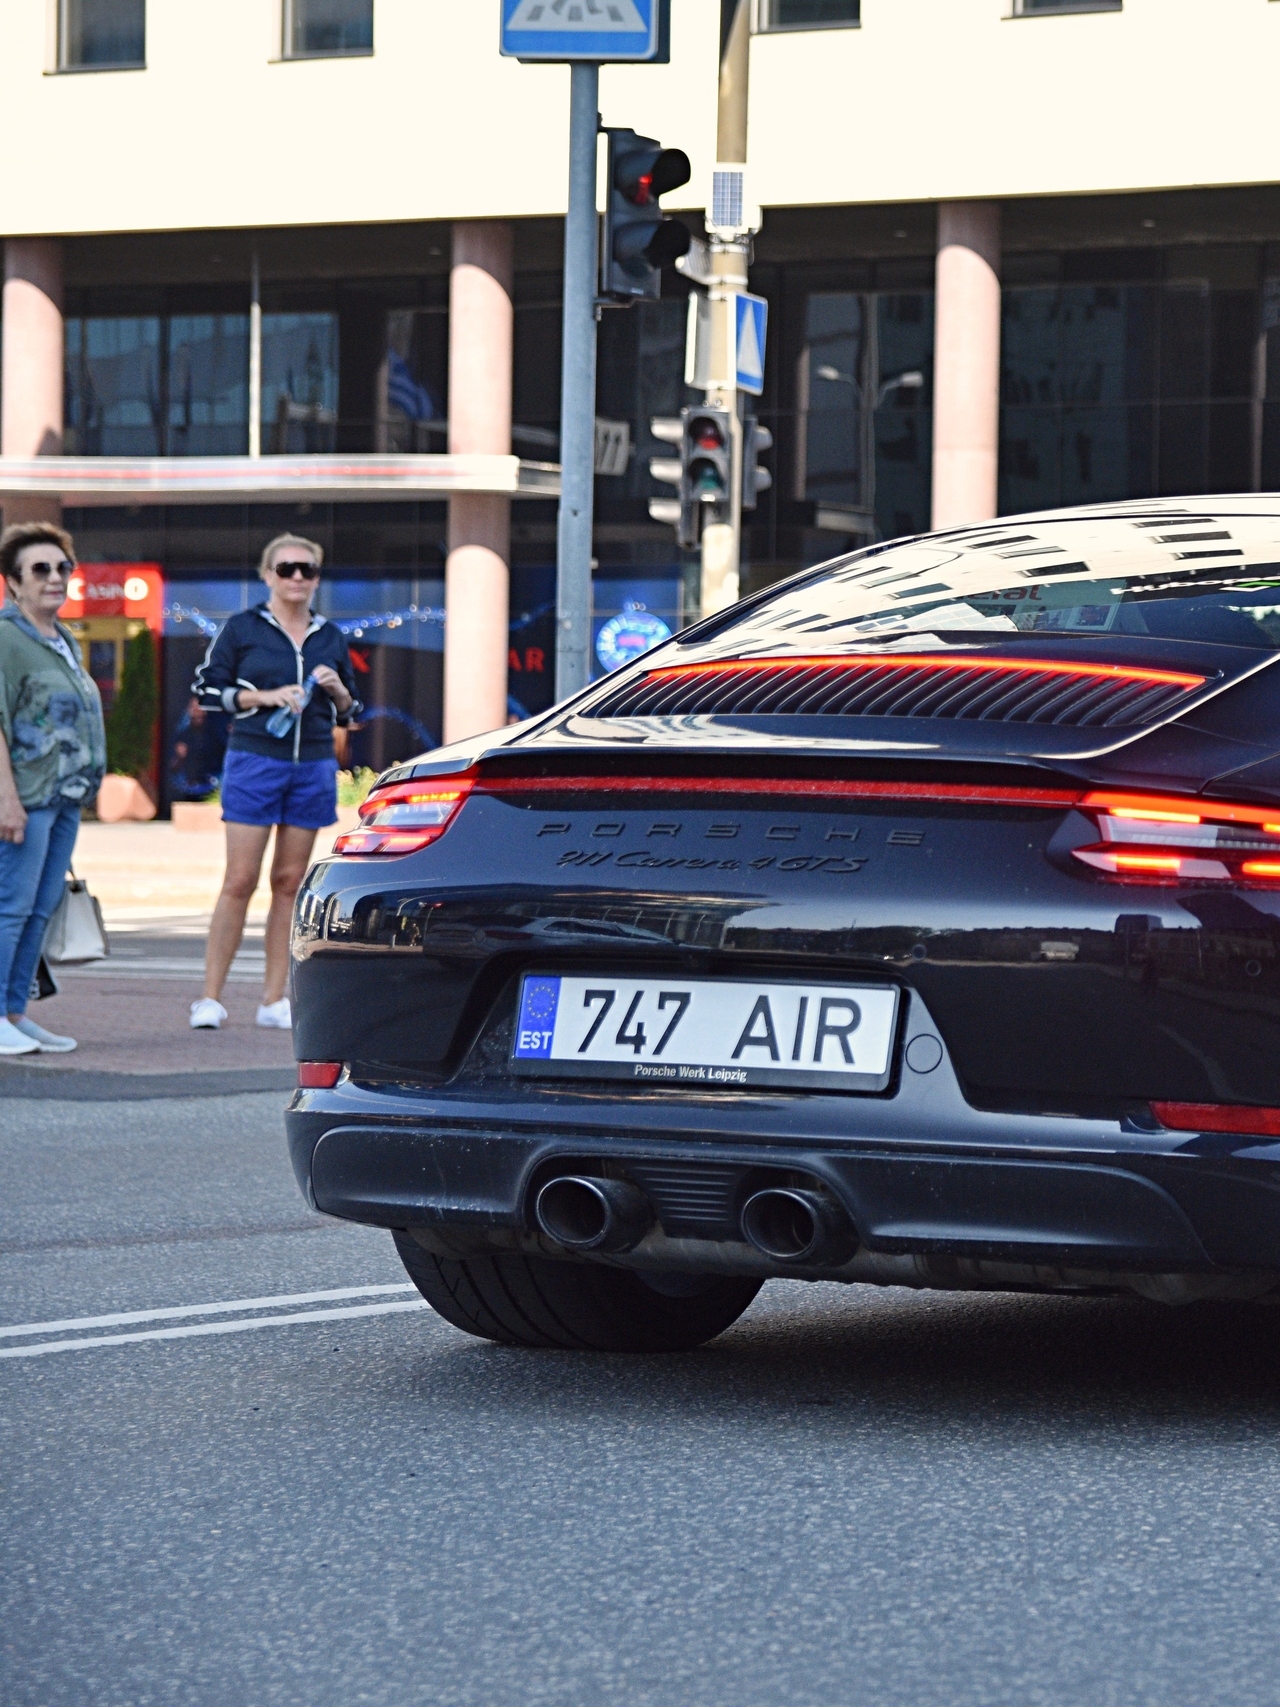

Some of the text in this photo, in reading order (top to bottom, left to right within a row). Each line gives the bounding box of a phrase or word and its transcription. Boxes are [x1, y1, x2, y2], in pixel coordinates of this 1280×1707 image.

[537, 822, 925, 846] PORSCHE
[556, 849, 868, 874] 911 Carrera 4 GTS
[578, 989, 862, 1064] 747 AIR
[519, 1031, 553, 1050] EST
[634, 1063, 748, 1083] Porsche Werk Leipzig
